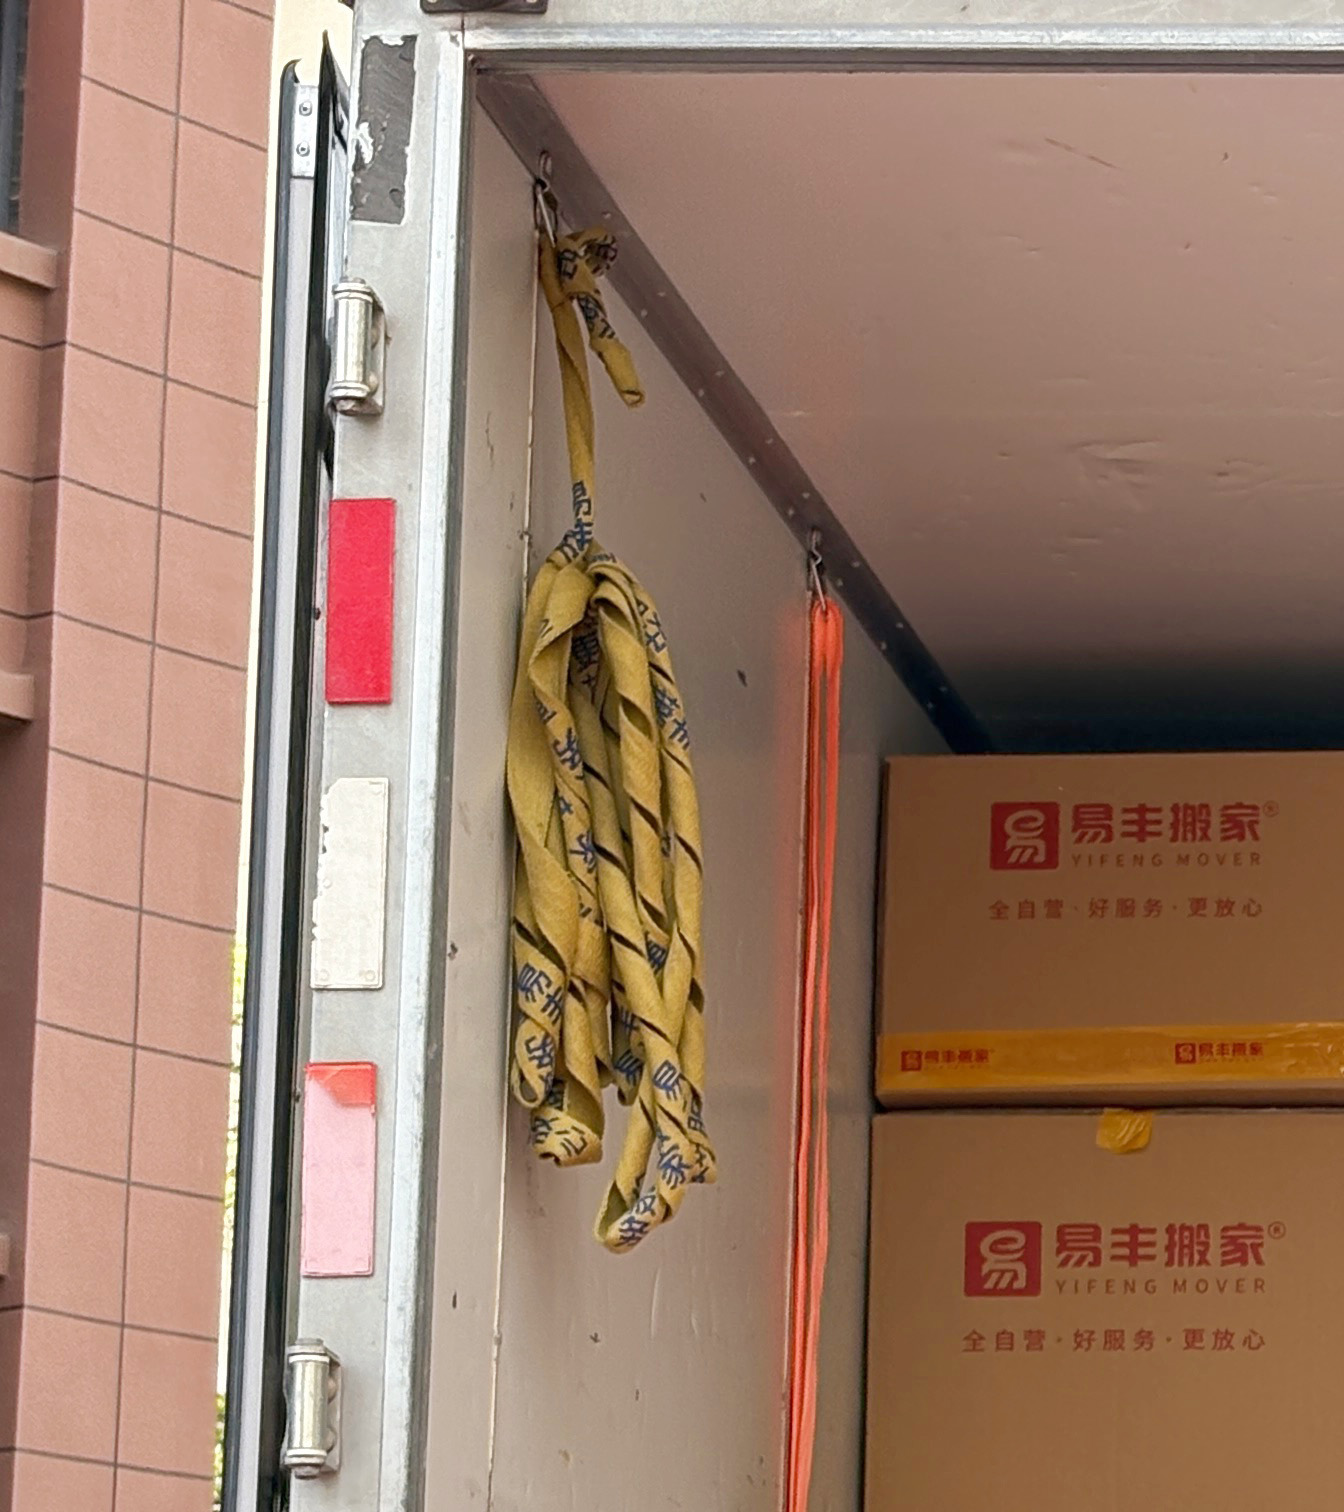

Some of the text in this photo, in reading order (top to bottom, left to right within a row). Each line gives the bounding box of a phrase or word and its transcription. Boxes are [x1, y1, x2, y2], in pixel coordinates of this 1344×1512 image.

[1071, 852, 1261, 868] YIFENG MOVER
[1056, 1278, 1267, 1295] YIFENG MOVER
